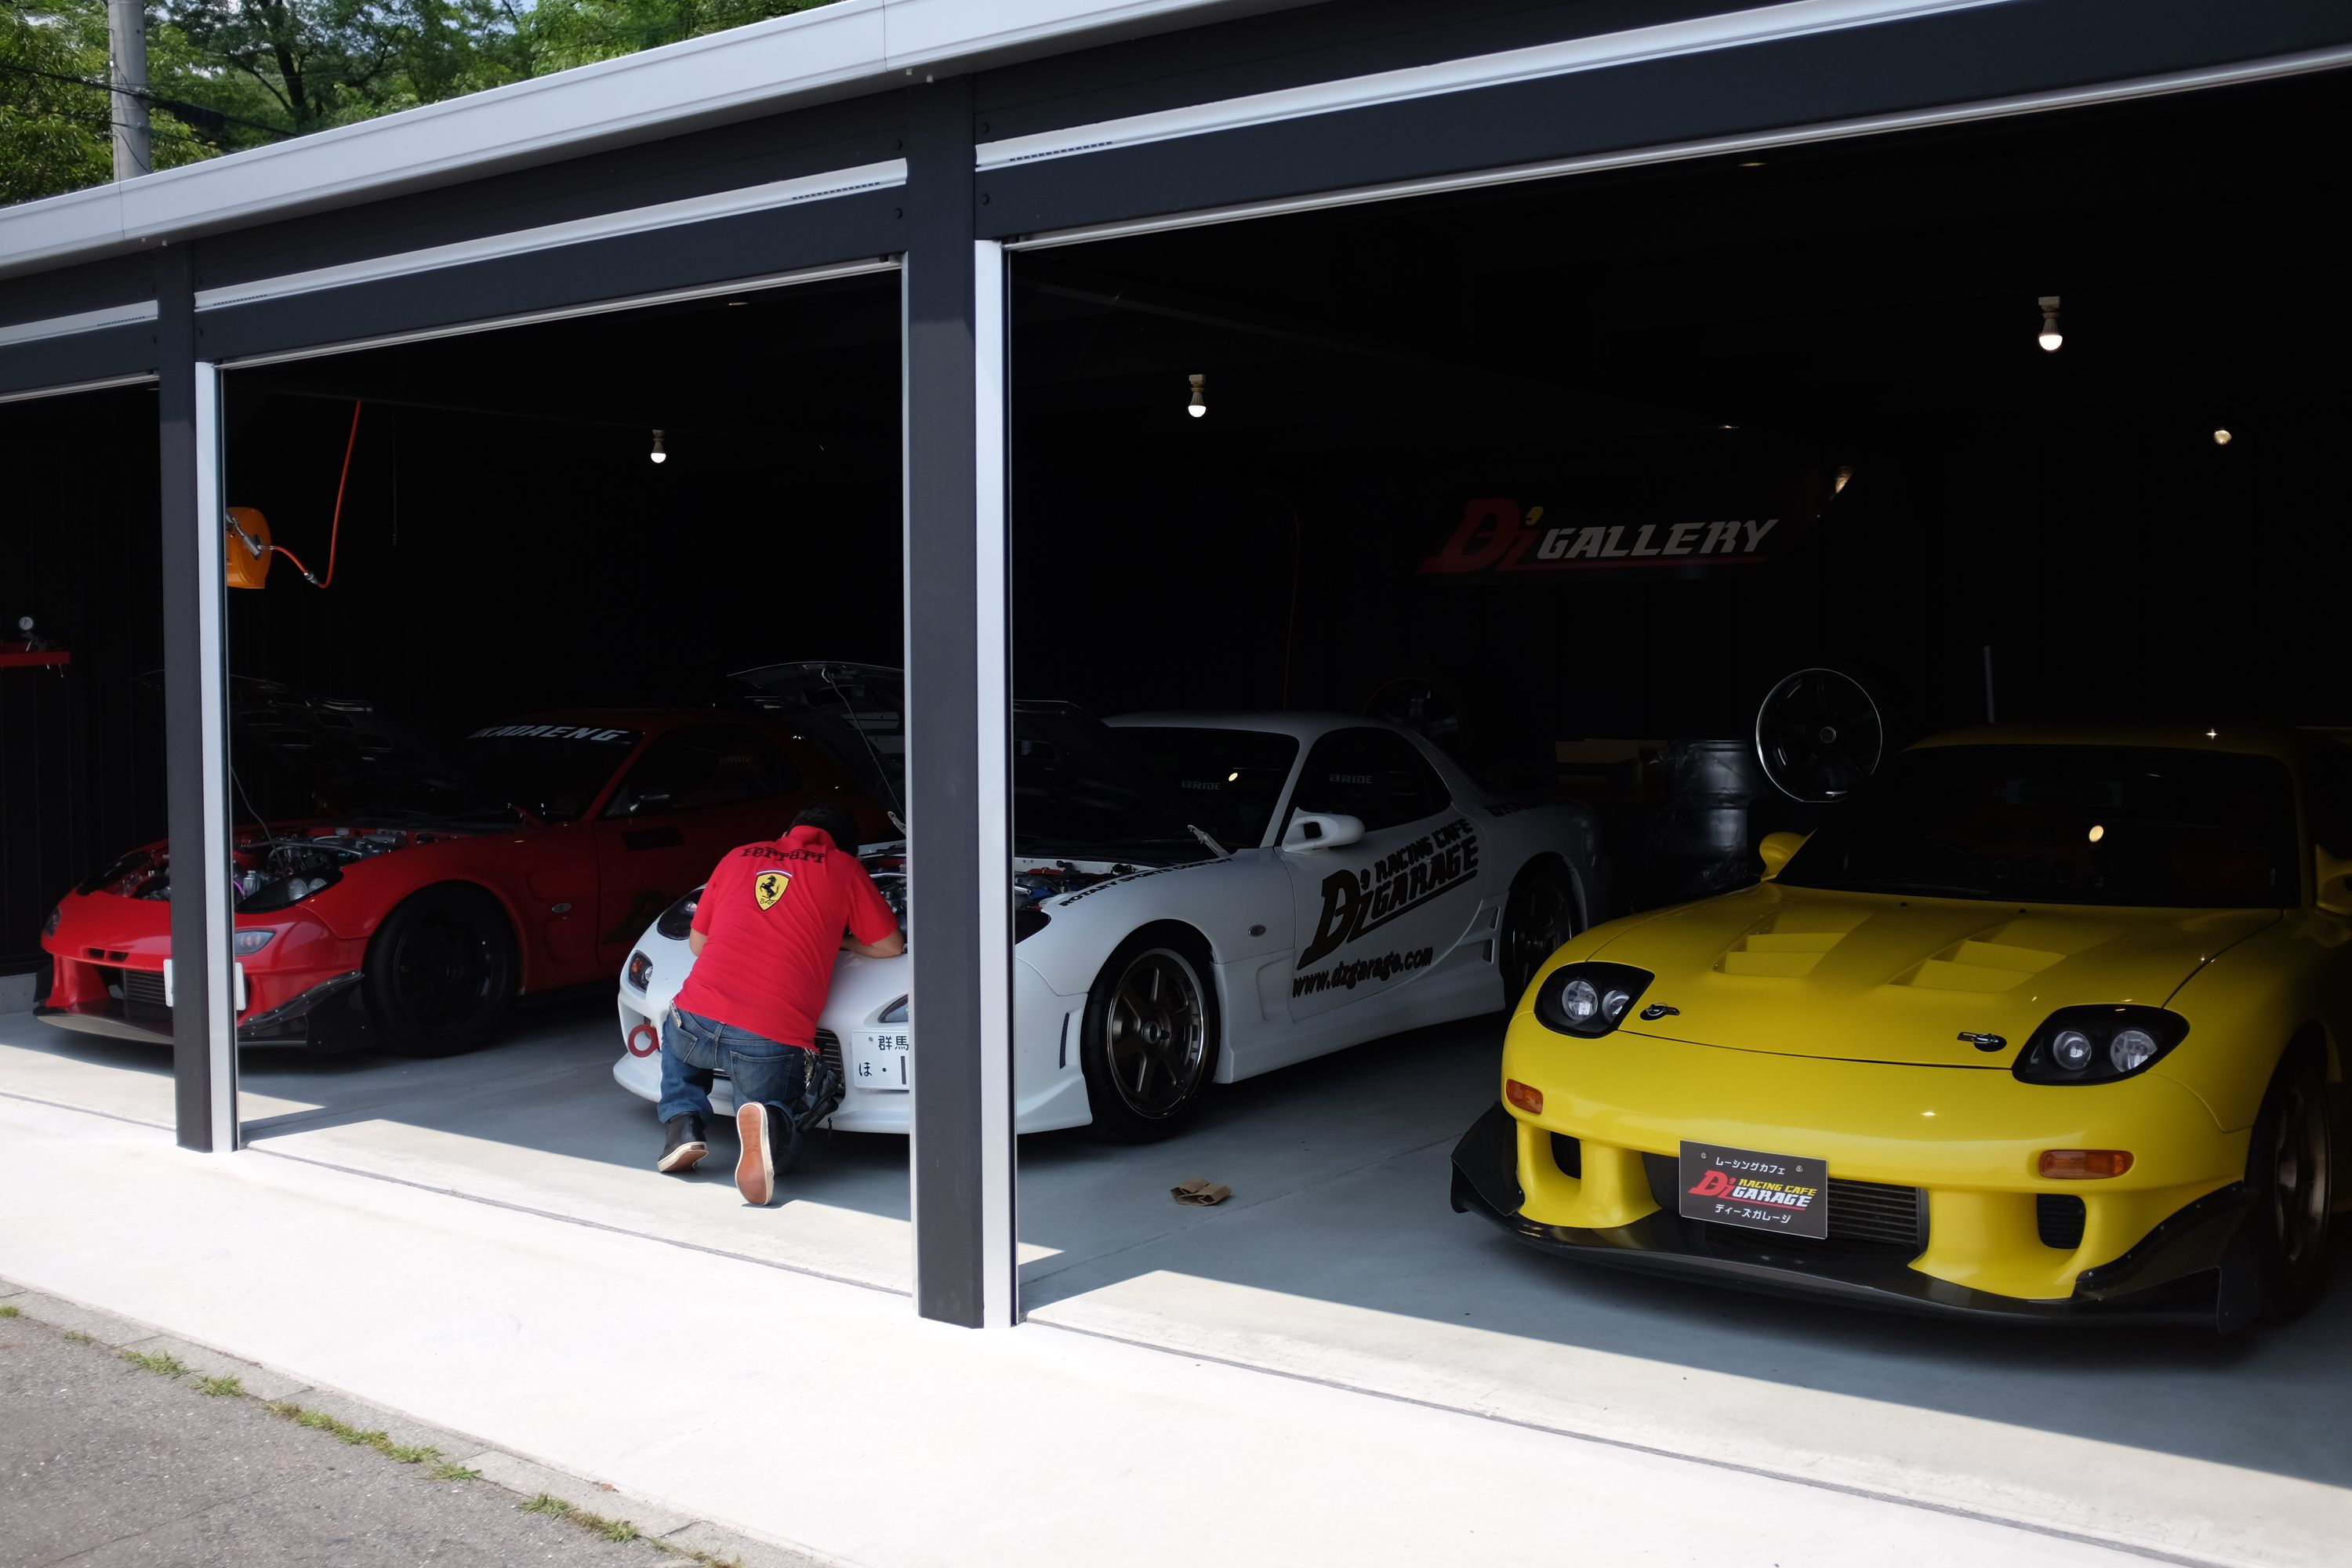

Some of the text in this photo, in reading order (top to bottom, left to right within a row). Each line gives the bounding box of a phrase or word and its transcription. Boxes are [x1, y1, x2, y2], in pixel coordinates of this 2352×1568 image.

[1537, 518, 1780, 560] GALLERY
[1181, 780, 1221, 791] BRIDE
[1328, 773, 1373, 784] BRIDE
[739, 846, 826, 864] Ferrari
[1374, 836, 1434, 883] RACING
[1432, 818, 1474, 849] CAFE
[1370, 835, 1479, 920] GARAGE
[1291, 946, 1434, 999] www.dzgarage.com
[877, 1035, 909, 1051] 群馬
[858, 1061, 873, 1077] ほ
[1715, 1156, 1786, 1174] レーシングカフェ
[1732, 1185, 1813, 1207] GARAGE
[1738, 1178, 1784, 1191] RACING
[1784, 1185, 1818, 1196] CAFE
